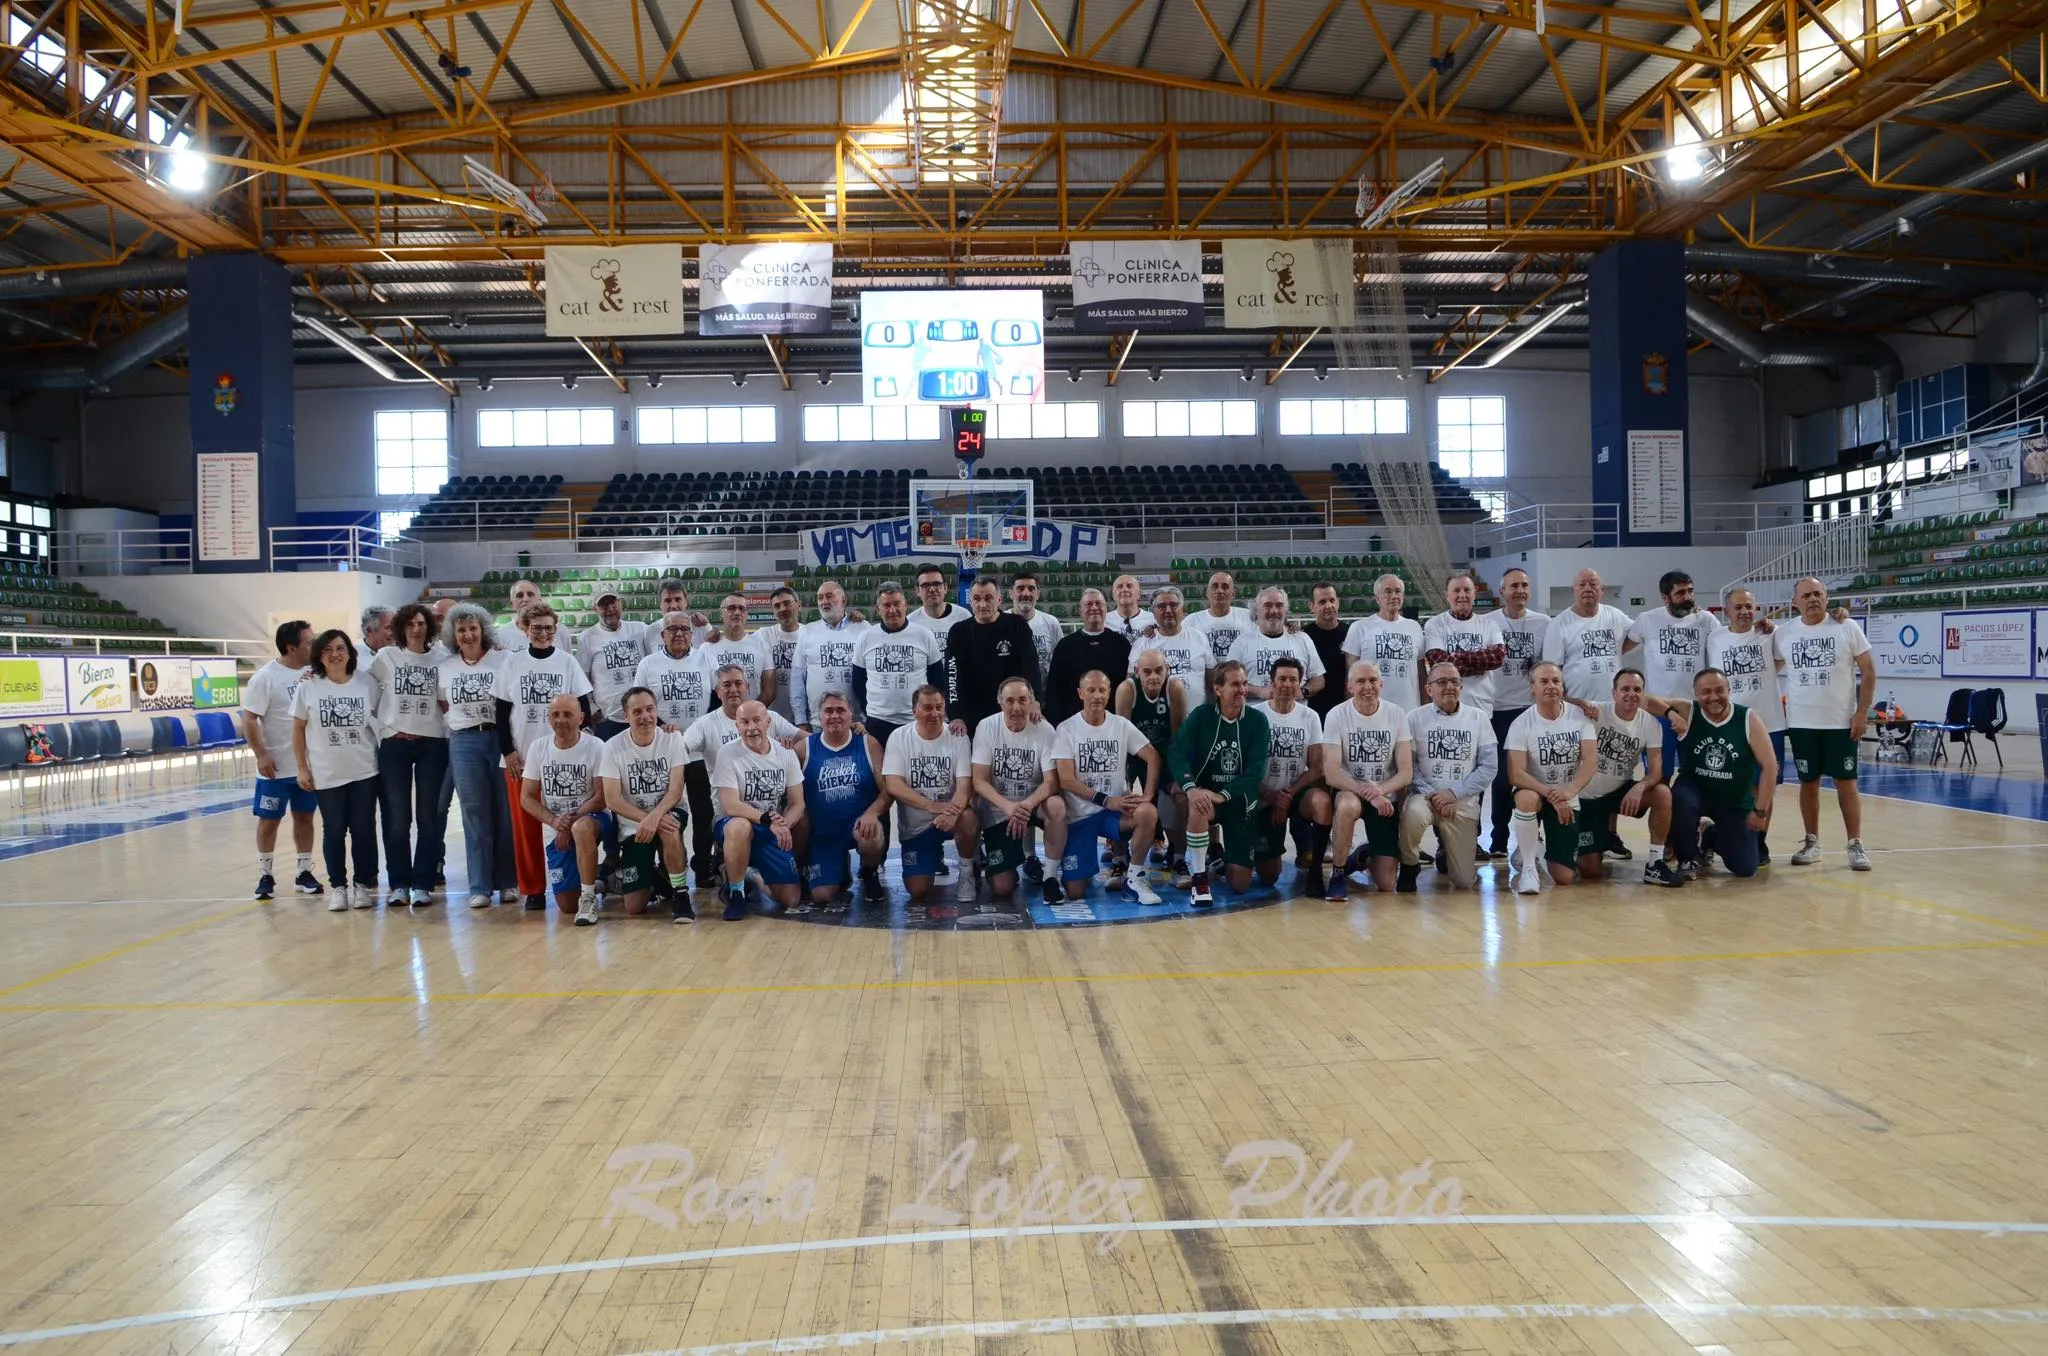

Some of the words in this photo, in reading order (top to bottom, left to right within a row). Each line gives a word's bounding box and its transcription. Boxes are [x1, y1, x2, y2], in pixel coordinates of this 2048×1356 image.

[736, 276, 830, 287] PONFERRADA
[1107, 272, 1200, 284] PONFERRADA
[560, 301, 590, 315] cat
[633, 299, 669, 313] rest
[1237, 291, 1266, 307] cat
[1305, 291, 1341, 307] rest
[715, 312, 734, 321] MÁS
[735, 313, 765, 321] SALUD.
[766, 311, 786, 320] MÁS
[786, 312, 817, 320] BIERZO
[1087, 308, 1107, 318] MÁS
[1107, 309, 1137, 317] SALUD.
[1138, 308, 1157, 317] MÁS
[1158, 308, 1189, 317] BIERZO
[884, 325, 895, 343] 0
[1011, 324, 1021, 341] 0
[938, 371, 978, 395] 1:00
[958, 431, 982, 451] 24
[811, 518, 911, 565] VAMOS
[1880, 654, 1896, 664] TU
[1898, 651, 1941, 665] VISIÓN
[79, 661, 115, 685] Bierzo
[3, 682, 39, 693] CUEVAS
[211, 687, 238, 705] ERBI
[1157, 697, 1167, 714] 6
[1693, 736, 1714, 754] CLUB
[819, 762, 858, 781] Basket
[1695, 767, 1733, 779] PONFERRADA
